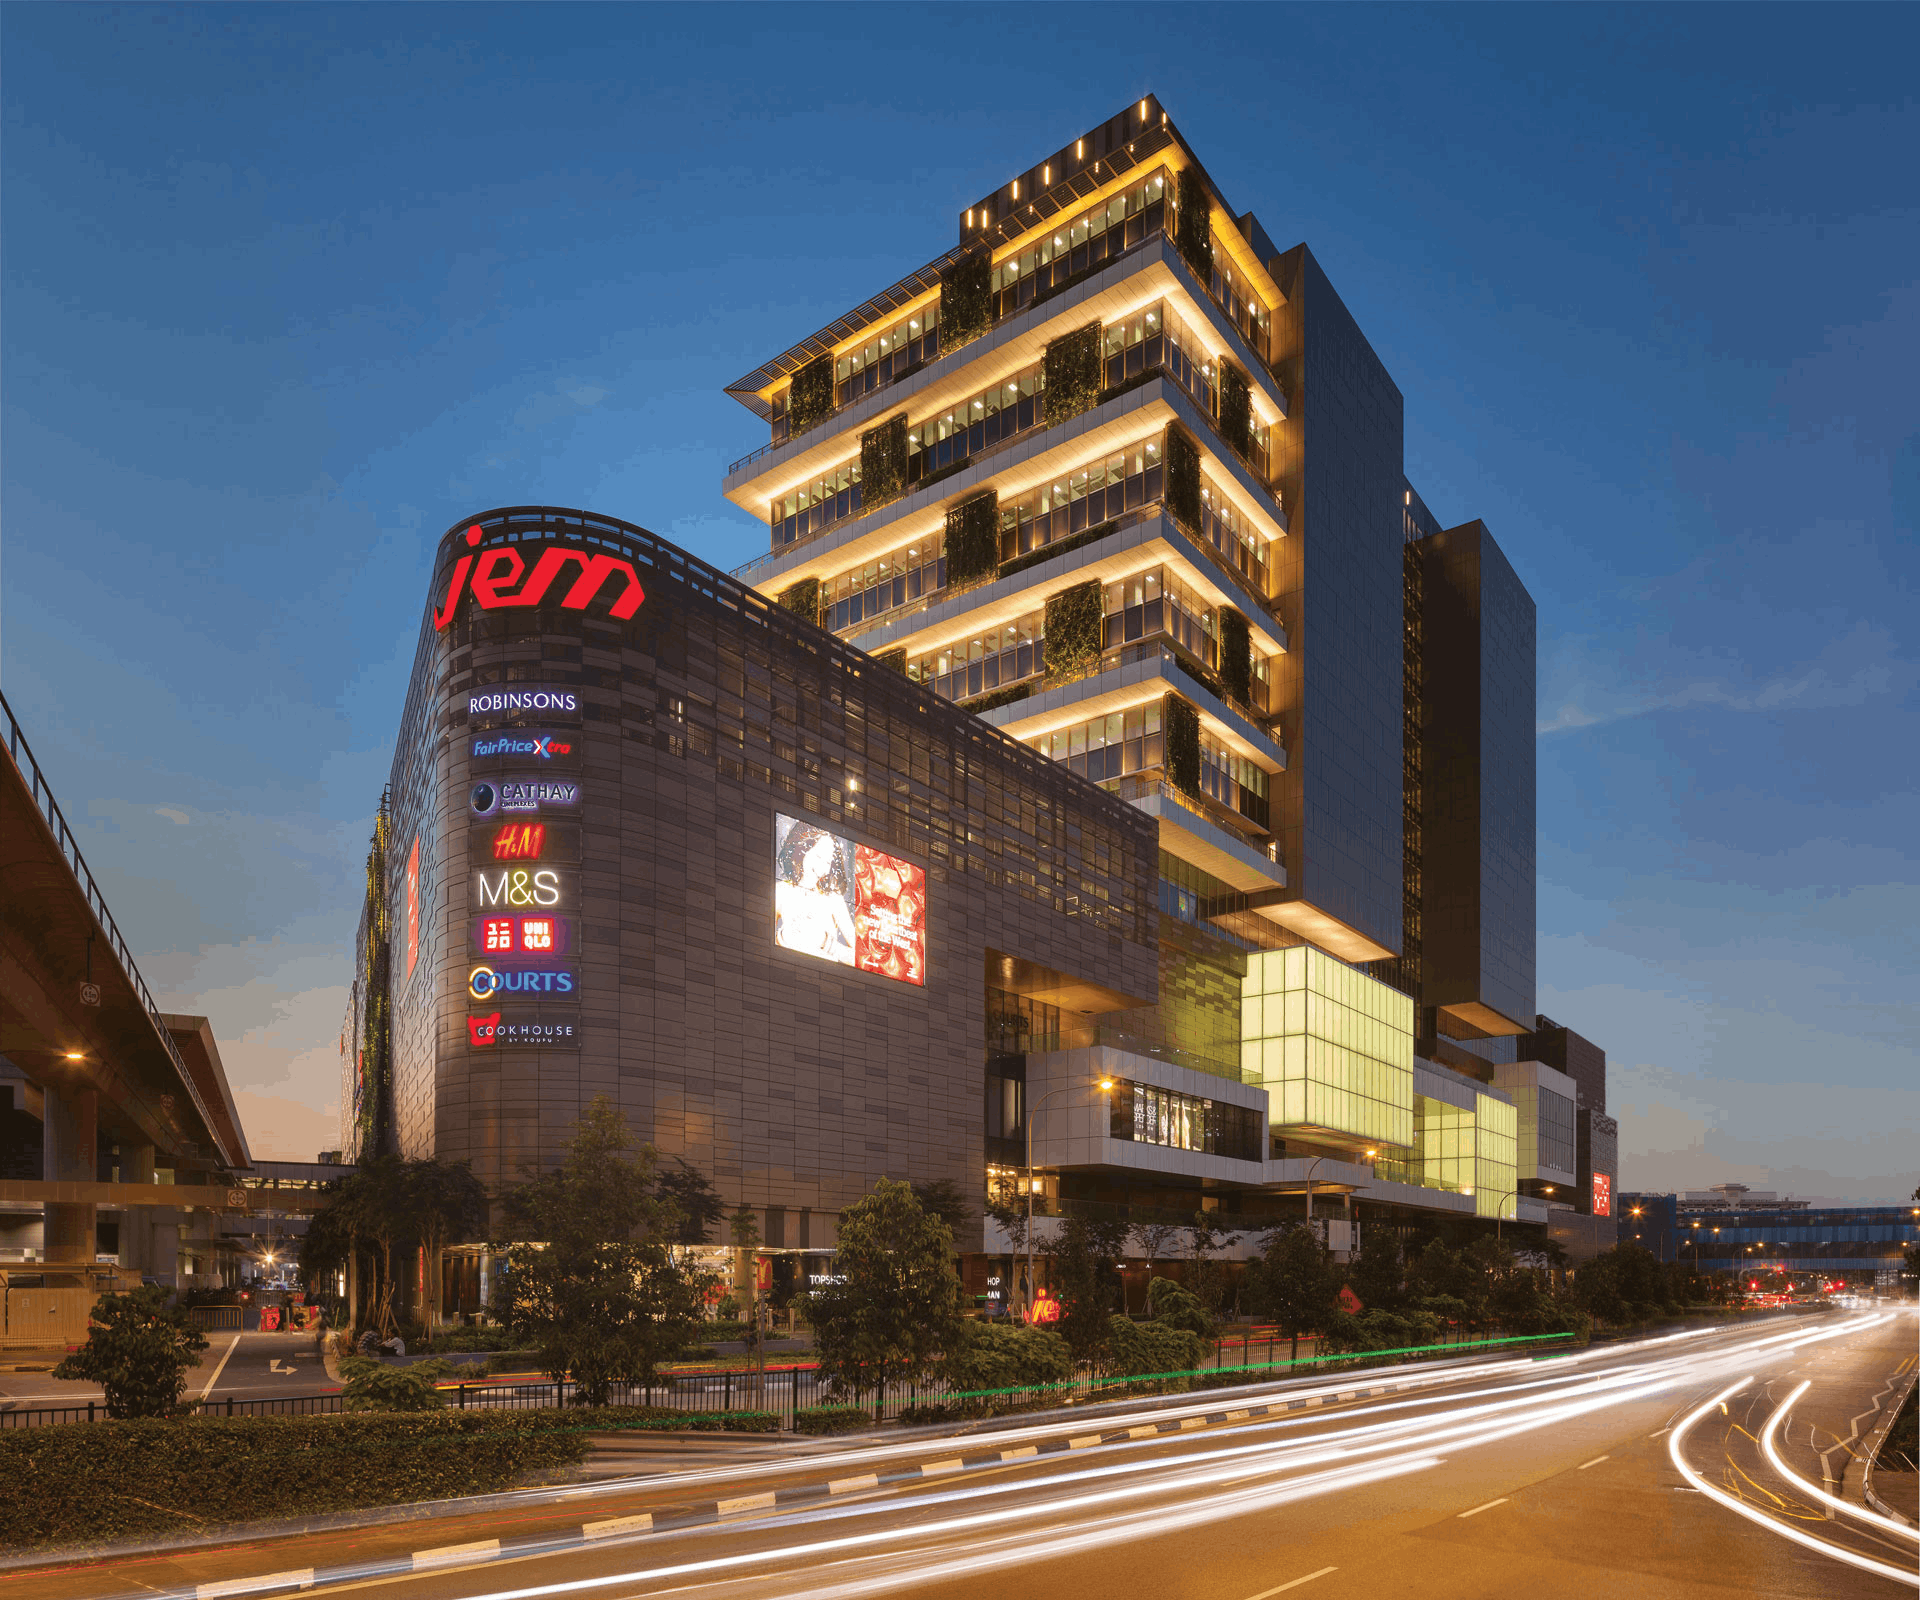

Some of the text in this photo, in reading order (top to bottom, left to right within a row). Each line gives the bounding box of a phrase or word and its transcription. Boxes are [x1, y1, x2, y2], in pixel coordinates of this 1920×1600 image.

[434, 524, 646, 632] jem
[470, 692, 577, 714] ROBINSONS
[501, 783, 576, 801] CATHAY
[495, 824, 545, 860] H&M
[479, 870, 559, 907] M&S
[473, 970, 573, 994] COURTS
[477, 1025, 574, 1037] COOKHOUSE
